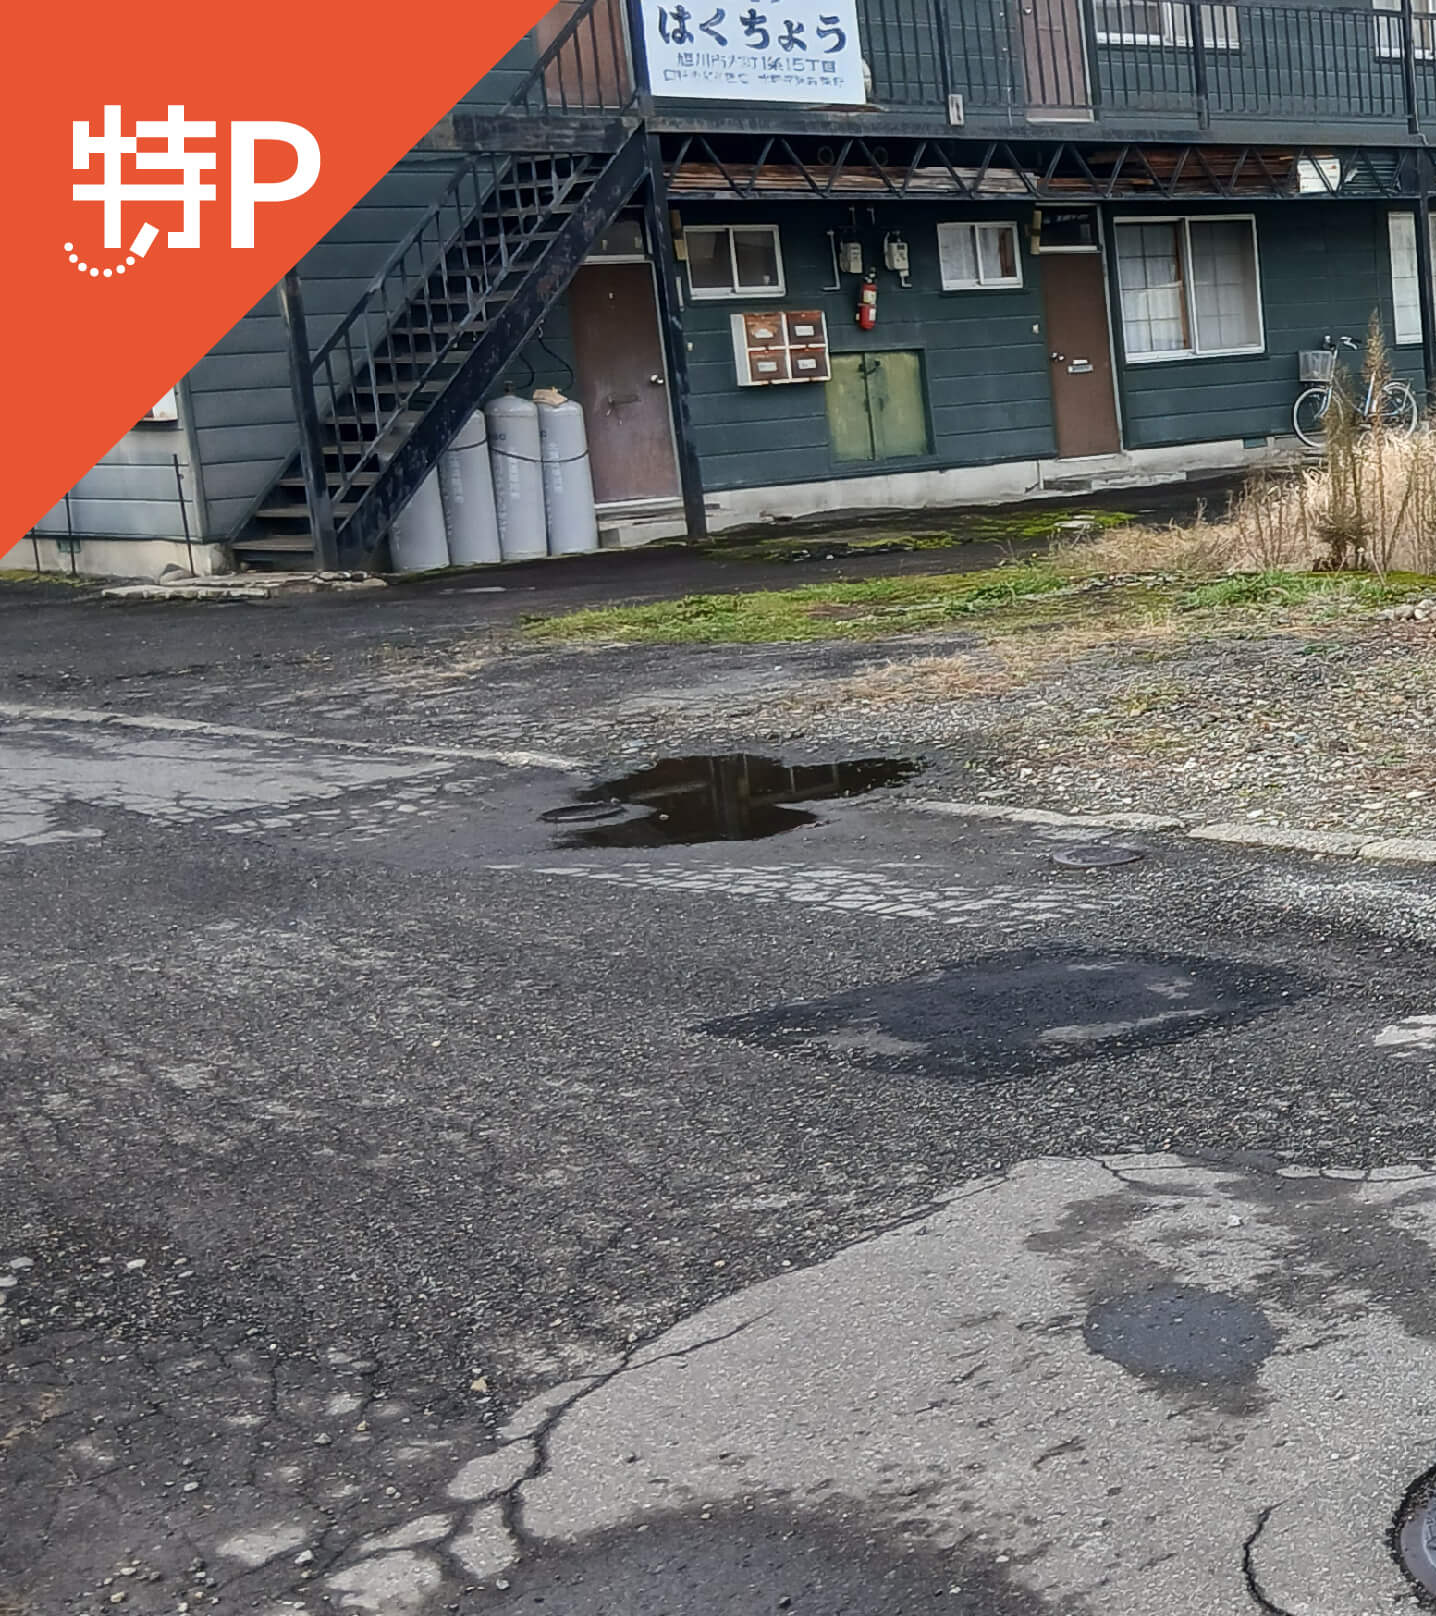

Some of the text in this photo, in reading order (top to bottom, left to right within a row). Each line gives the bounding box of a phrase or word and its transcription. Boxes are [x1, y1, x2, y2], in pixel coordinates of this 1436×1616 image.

[658, 5, 846, 54] はくちょう
